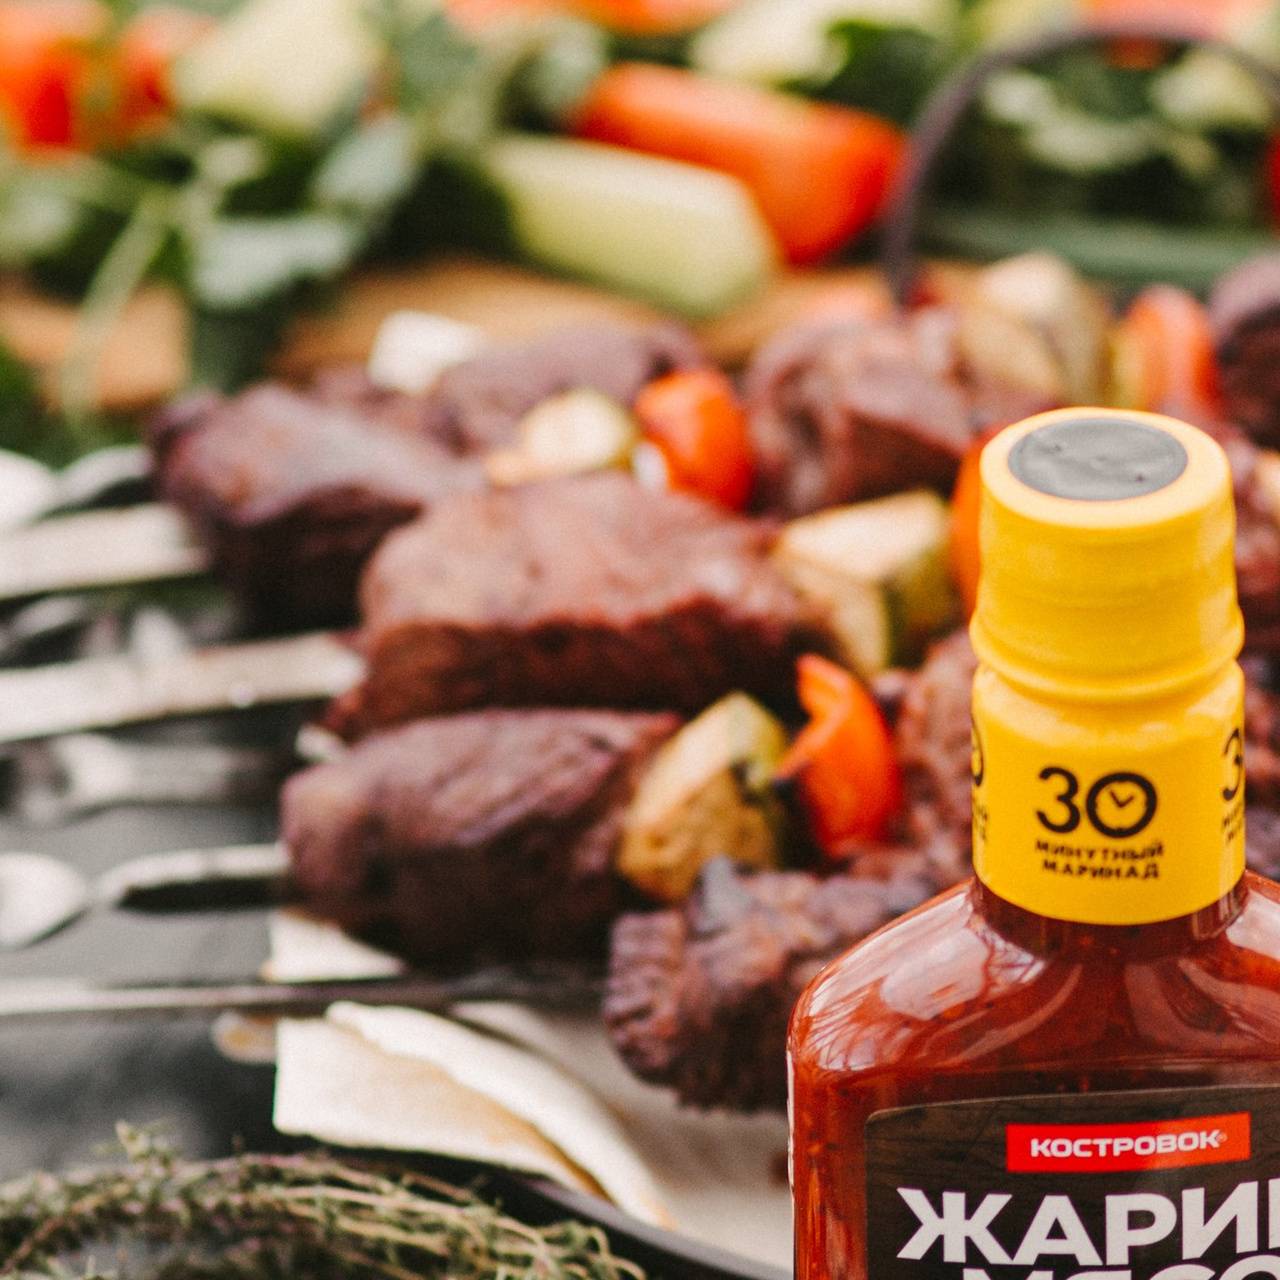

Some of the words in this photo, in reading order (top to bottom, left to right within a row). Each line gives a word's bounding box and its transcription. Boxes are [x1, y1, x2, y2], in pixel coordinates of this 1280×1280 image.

[1036, 766, 1157, 839] 30
[1035, 838, 1164, 862] МИНУТНЫЙ
[1042, 859, 1160, 881] МАРИНАД
